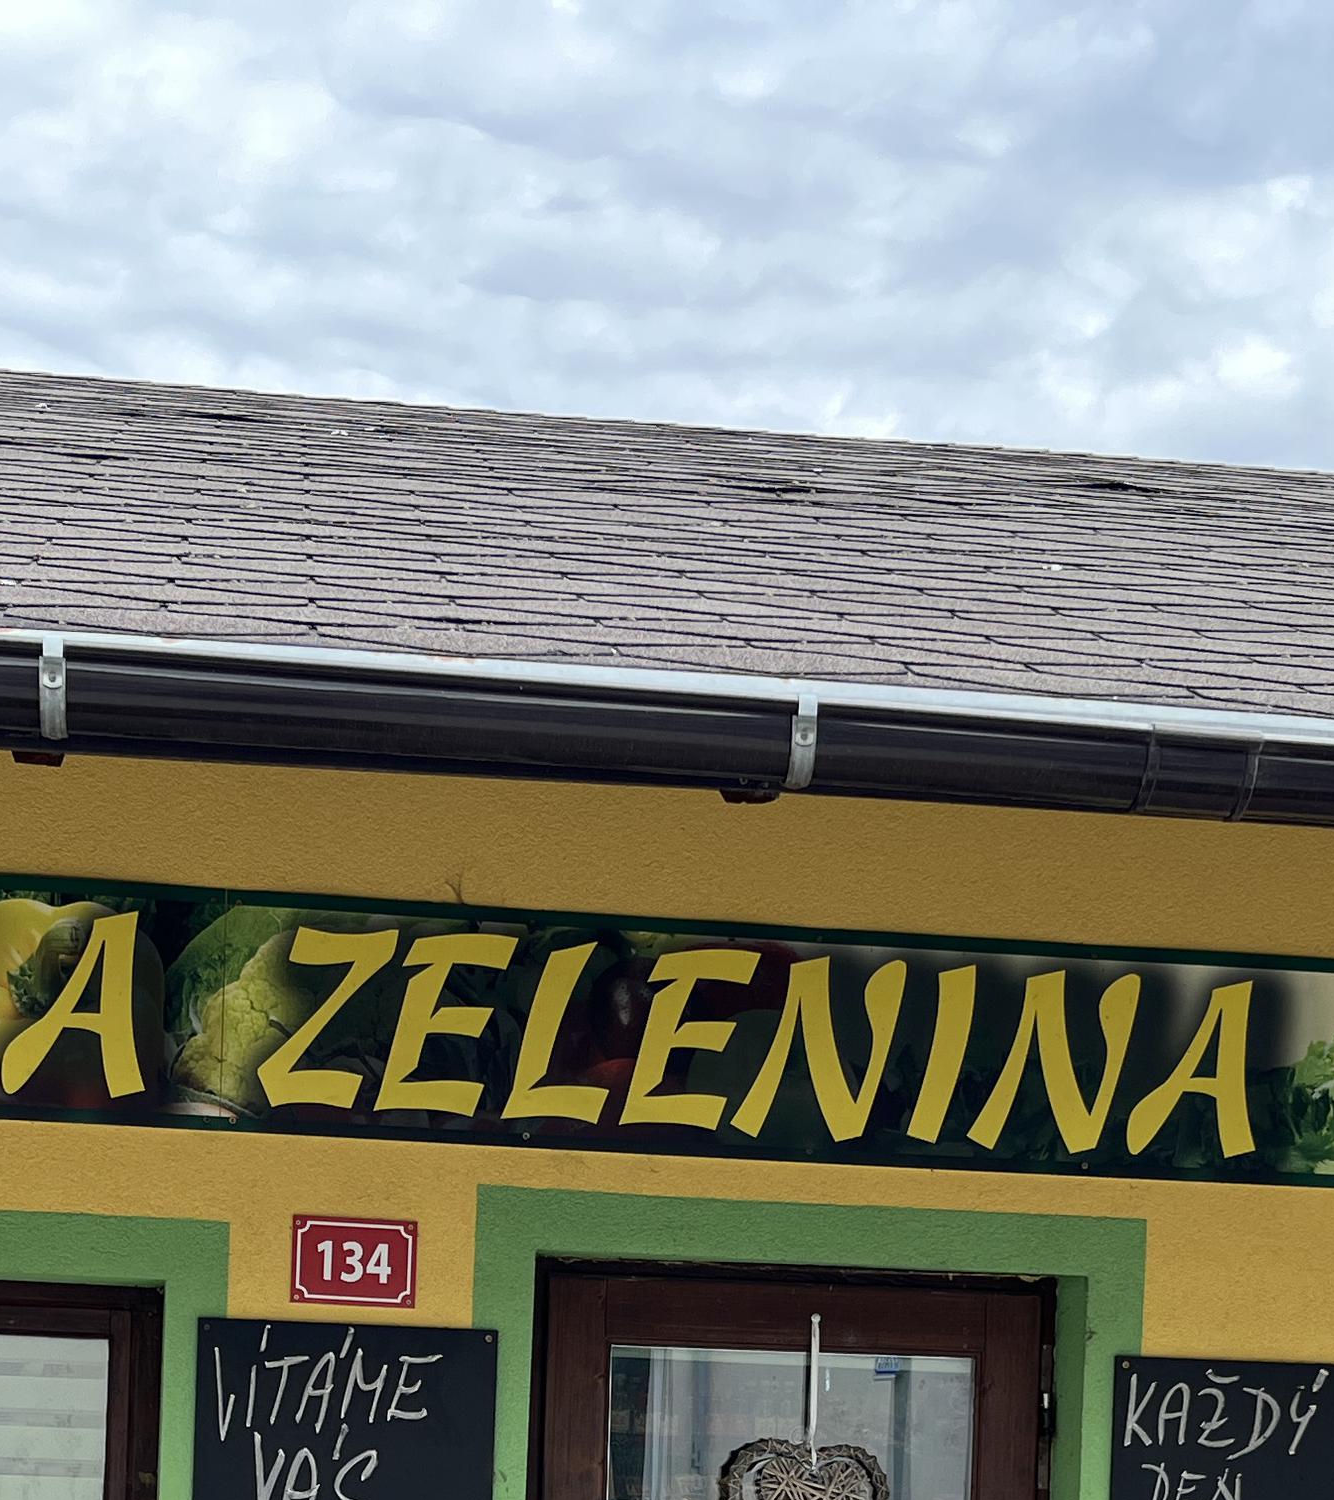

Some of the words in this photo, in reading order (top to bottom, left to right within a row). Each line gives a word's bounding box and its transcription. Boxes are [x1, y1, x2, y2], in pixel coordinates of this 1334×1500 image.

[0, 910, 146, 1098] A
[257, 926, 1256, 1159] ZELENINA
[316, 1240, 392, 1285] 134
[213, 1325, 444, 1442] VÍTÁME
[1123, 1368, 1330, 1461] KAŽDÝ
